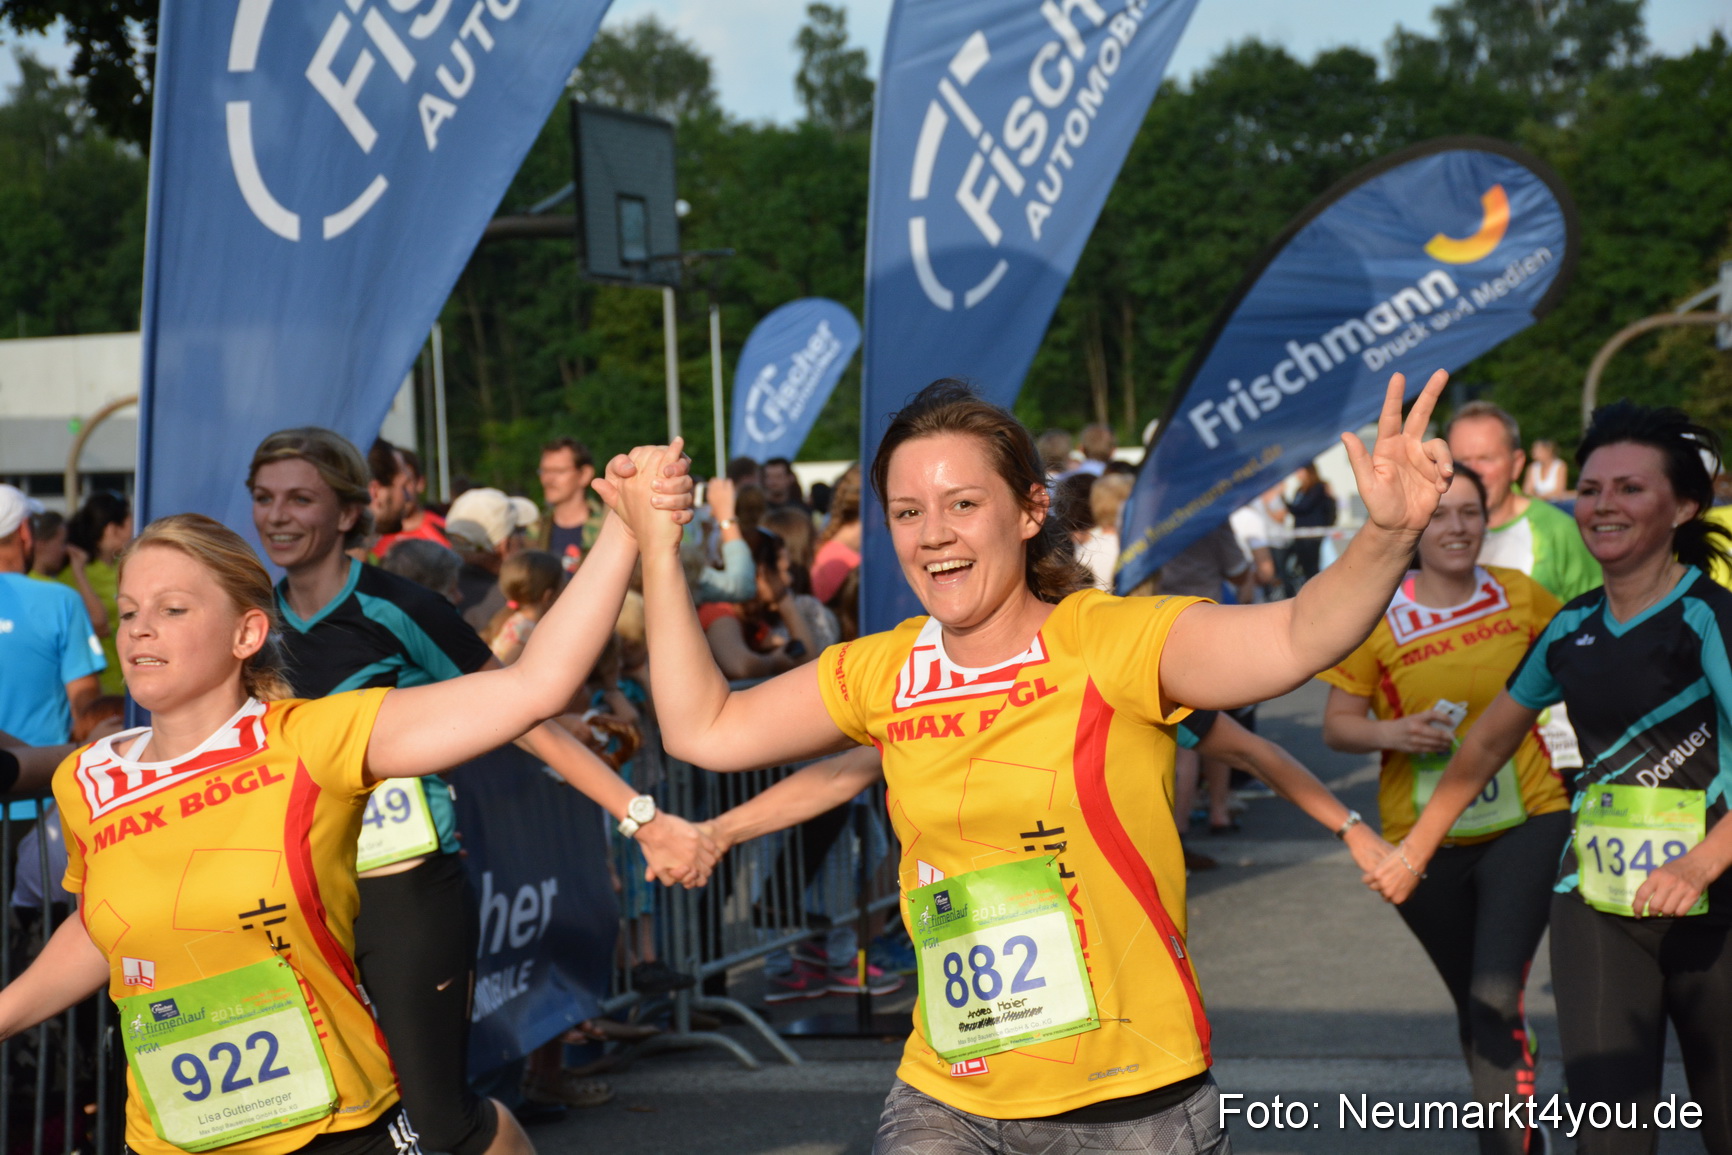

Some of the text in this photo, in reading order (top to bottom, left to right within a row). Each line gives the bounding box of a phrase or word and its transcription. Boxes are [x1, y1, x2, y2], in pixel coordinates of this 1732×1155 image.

[1362, 244, 1553, 373] Druck und Medien
[1188, 269, 1460, 449] Frischmann
[1400, 616, 1521, 666] MAX BÖGL
[886, 677, 1059, 744] MAX BGL
[1635, 721, 1712, 788] Donauer
[93, 764, 285, 855] MAX BÖGL
[931, 903, 1007, 928] firmenlauf 2016
[943, 935, 1047, 1008] 882
[145, 1004, 244, 1034] firmenlauf 2016
[1004, 1024, 1024, 1034] GmbH
[1042, 1018, 1052, 1026] KG
[171, 1030, 291, 1102] 922
[197, 1112, 221, 1126] Lisa
[222, 1091, 293, 1118] Guttenberger
[255, 1111, 273, 1121] GmbH
